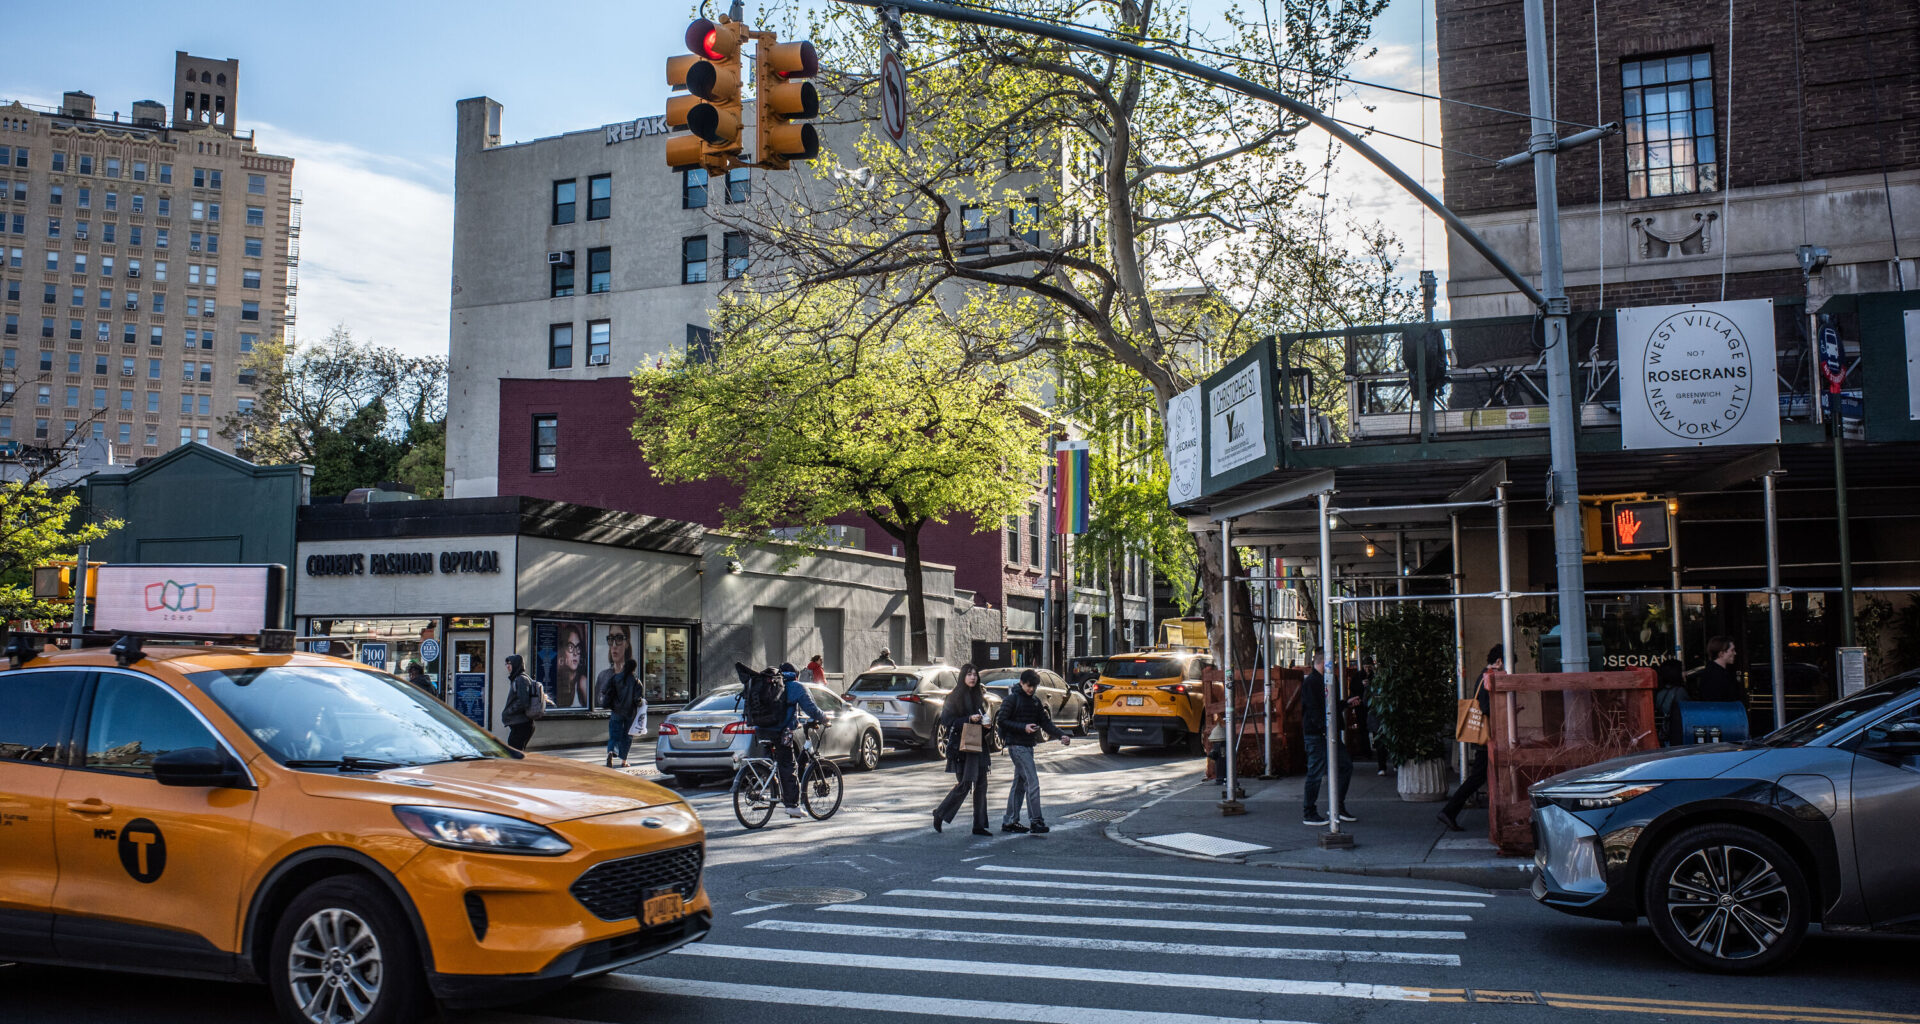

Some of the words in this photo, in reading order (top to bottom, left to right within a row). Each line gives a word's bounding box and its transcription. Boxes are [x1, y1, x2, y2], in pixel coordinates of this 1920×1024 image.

[1649, 323, 1677, 365] WEST
[1684, 315, 1744, 360] VILLAGE
[1648, 366, 1747, 383] ROSECRANS
[1216, 374, 1248, 412] CHRISTOPHER
[1248, 368, 1255, 393] ST
[1675, 391, 1721, 399] GREENWICH
[1651, 388, 1674, 421] NEW
[1677, 419, 1722, 435] YORK
[1724, 384, 1746, 421] CITY
[306, 553, 364, 577] COHEN'S
[370, 552, 434, 575] FASHION
[439, 550, 501, 575] OPTICAL
[363, 648, 385, 661] $100
[1603, 654, 1677, 667] SECRAN
[94, 828, 117, 840] NYC
[129, 831, 156, 875] T
